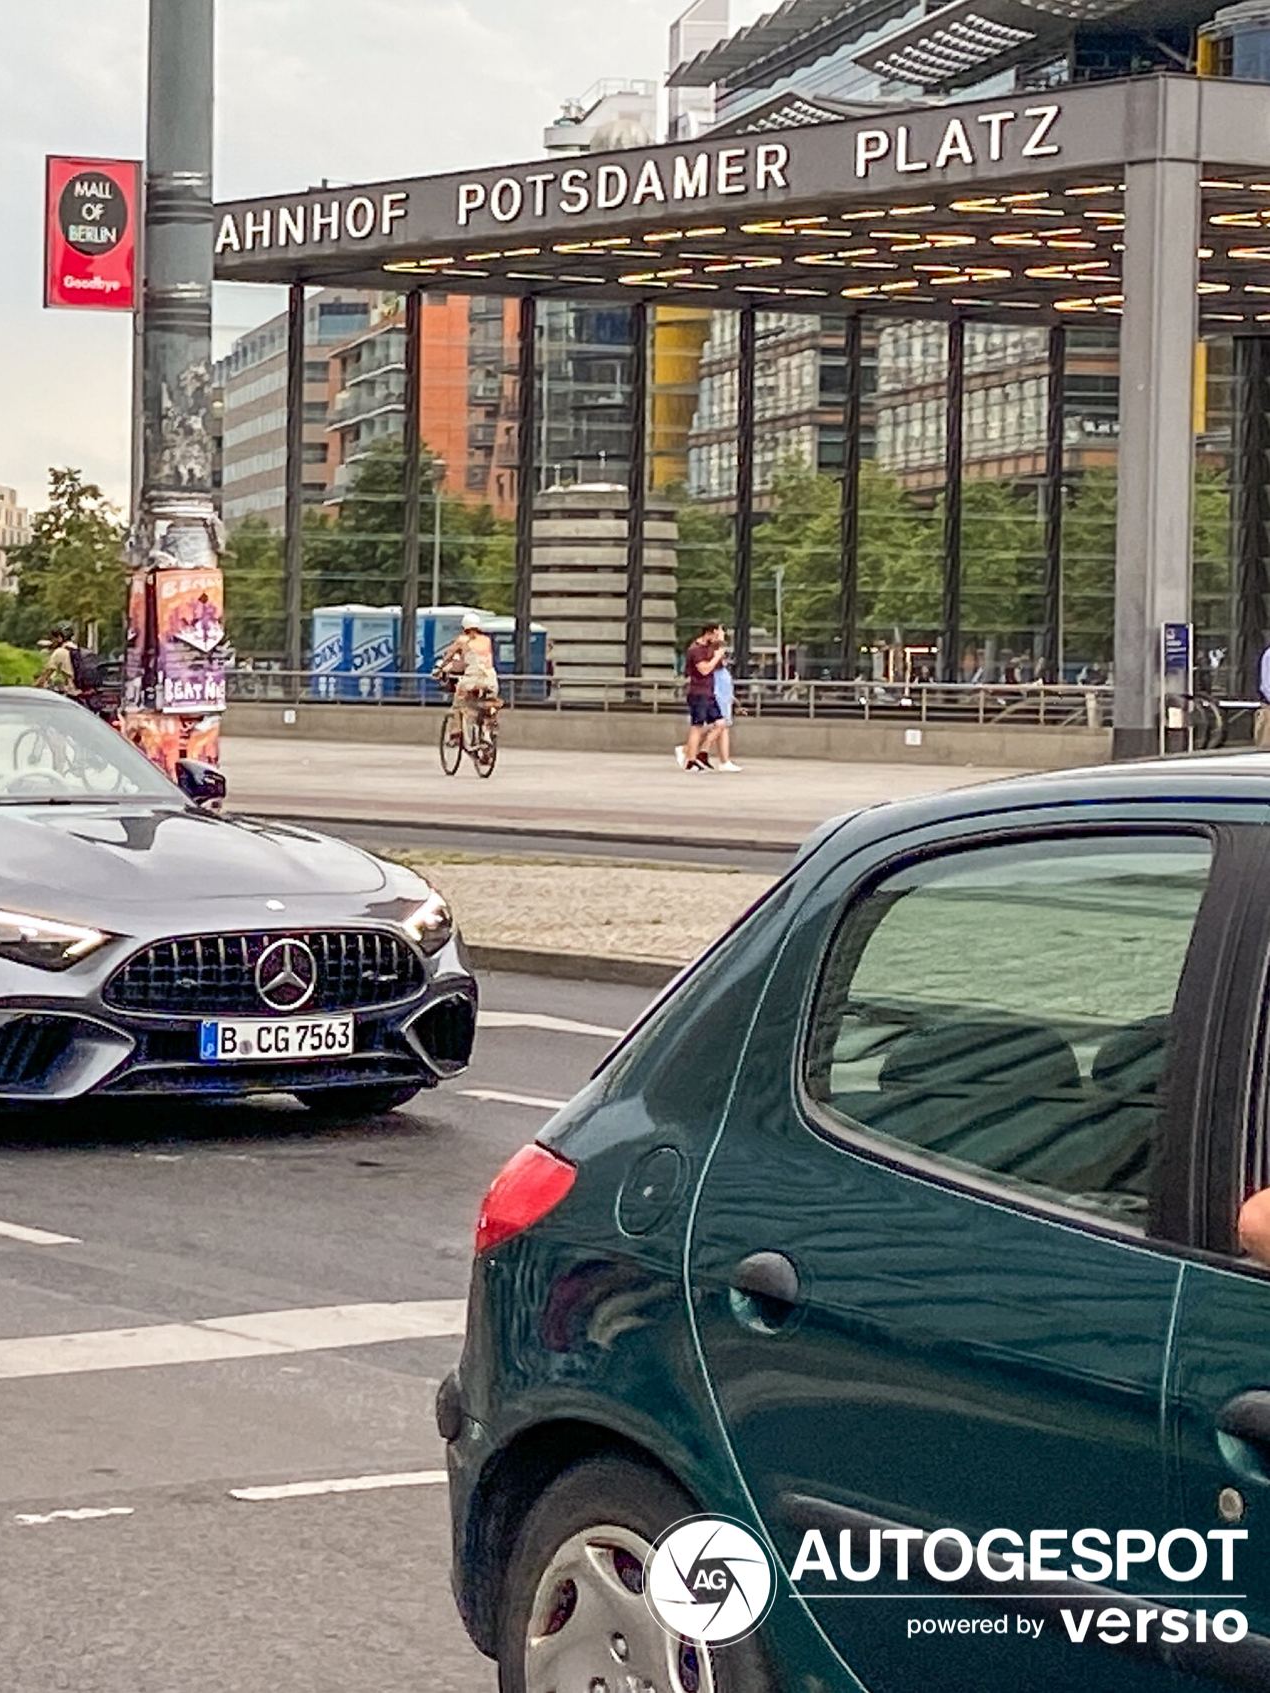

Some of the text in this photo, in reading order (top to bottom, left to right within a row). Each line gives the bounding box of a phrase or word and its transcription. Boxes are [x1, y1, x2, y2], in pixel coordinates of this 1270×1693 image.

[215, 104, 1063, 254] AHNHOF POTSDAMER PLATZ
[74, 181, 113, 199] MALL
[82, 202, 105, 222] OF
[68, 225, 117, 243] BERLIN
[63, 275, 121, 293] Goodbye
[352, 638, 393, 671] DIXI
[221, 1027, 238, 1054] B
[296, 1022, 350, 1050] 7563
